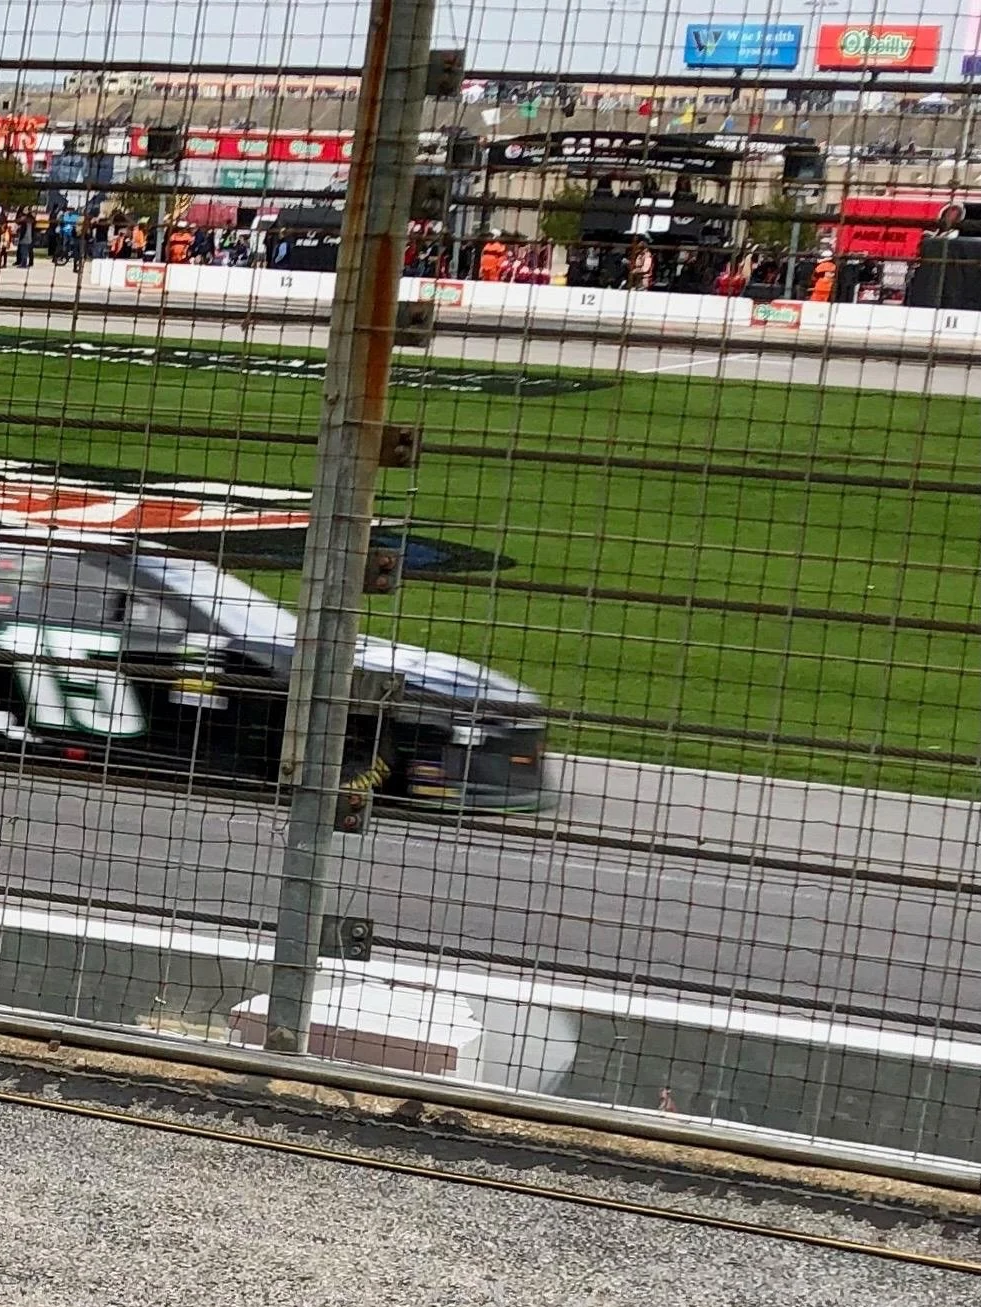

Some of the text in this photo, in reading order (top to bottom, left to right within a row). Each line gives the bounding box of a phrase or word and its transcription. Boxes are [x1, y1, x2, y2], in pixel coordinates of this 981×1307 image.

[842, 29, 911, 58] O'Reilly
[580, 293, 596, 306] 12
[945, 316, 959, 329] 11
